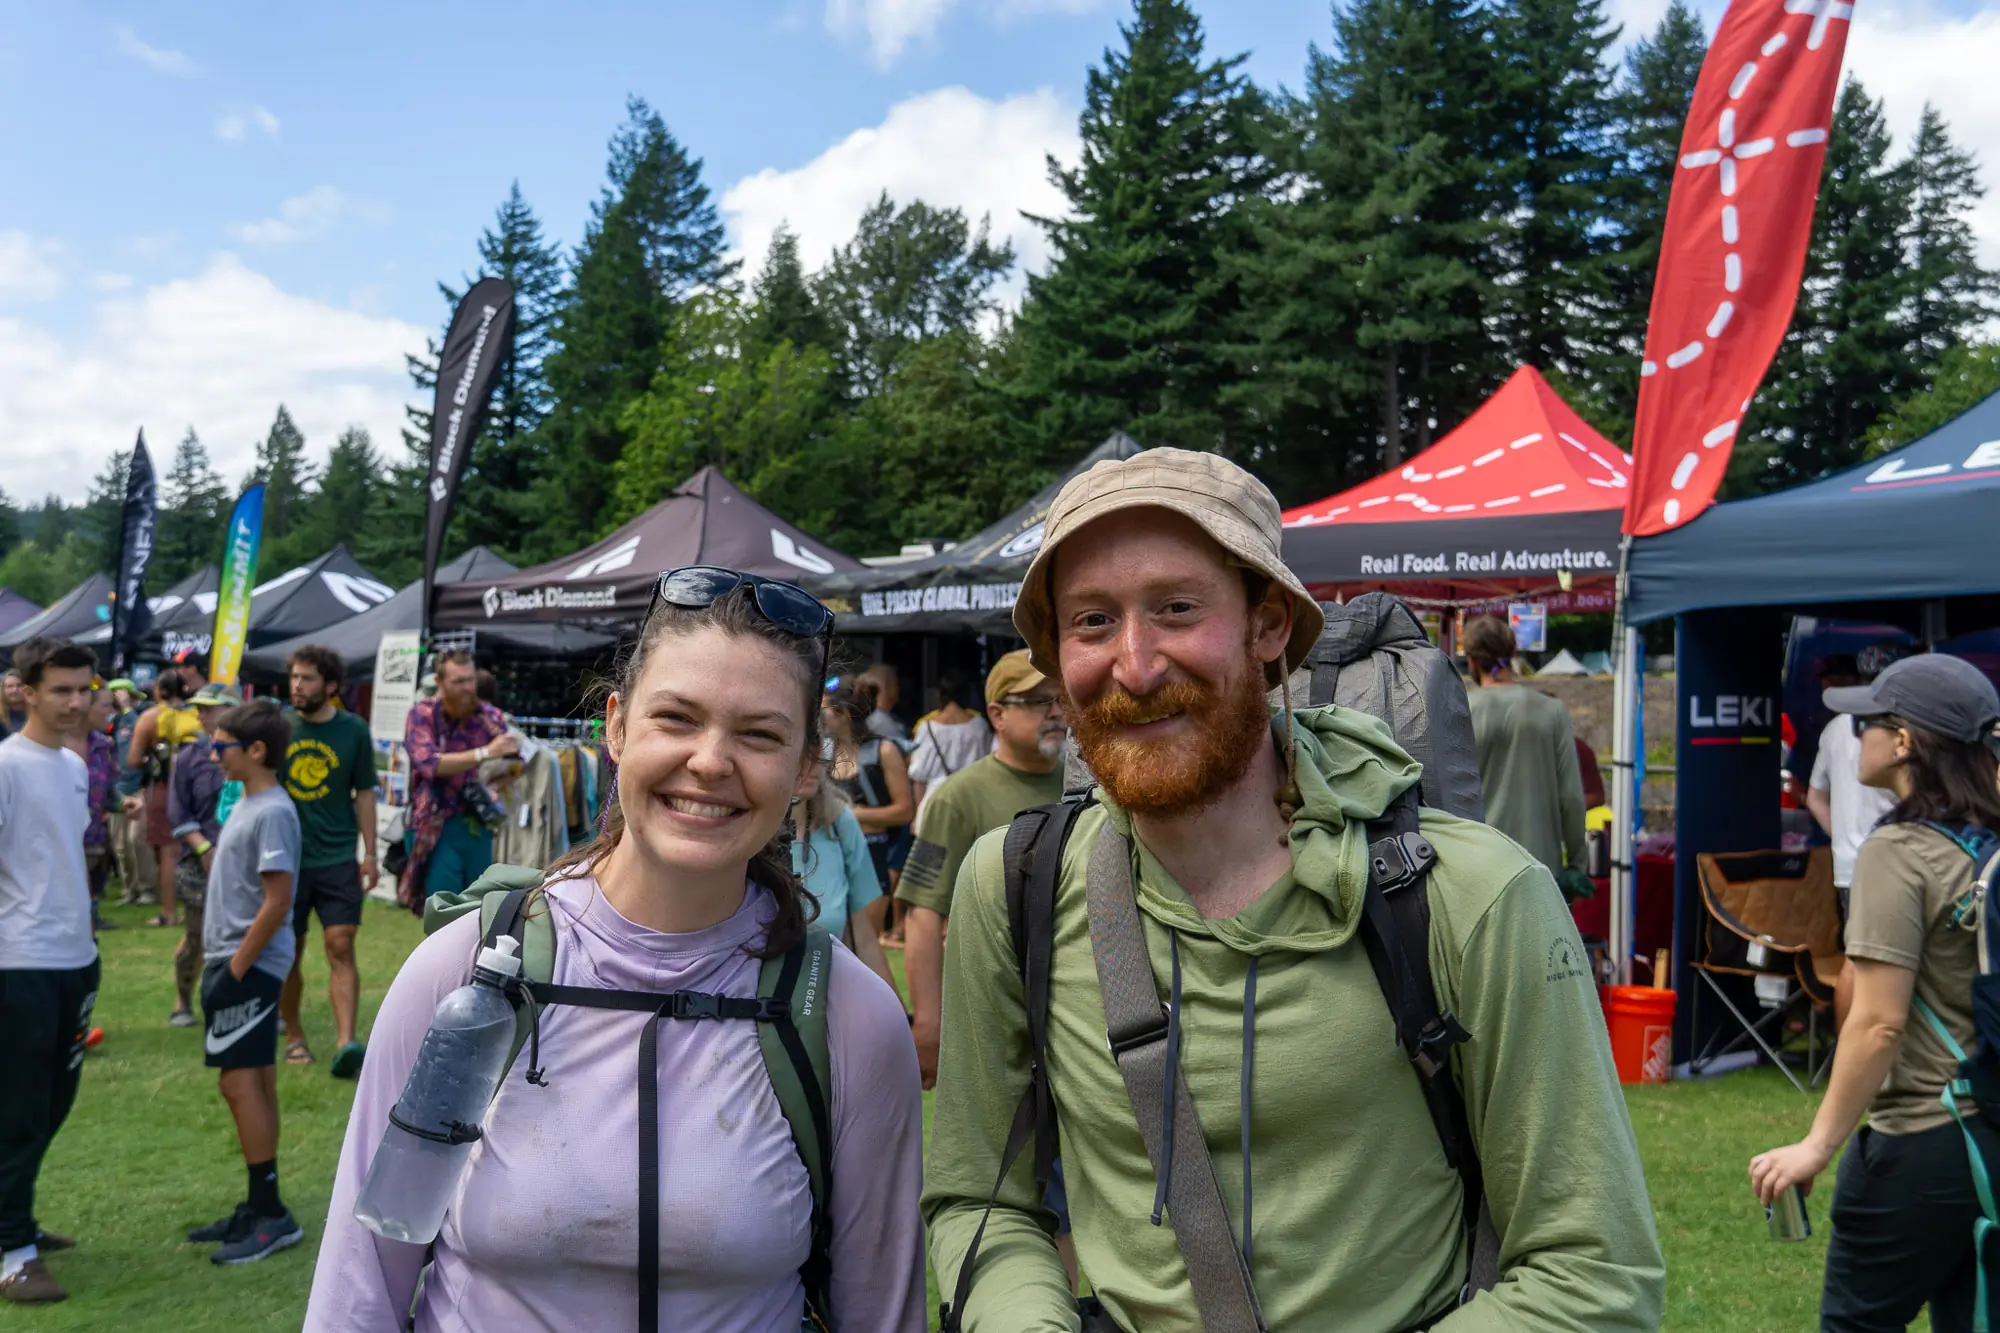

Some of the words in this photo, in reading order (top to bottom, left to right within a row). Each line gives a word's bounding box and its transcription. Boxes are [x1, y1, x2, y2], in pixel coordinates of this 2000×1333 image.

[437, 409, 463, 474] Black
[454, 305, 497, 405] Diamond
[1360, 555, 1399, 575] Real
[1402, 553, 1450, 574] Food.
[1455, 551, 1497, 572] Real
[1501, 548, 1613, 572] Adventure.
[223, 517, 251, 645] SUMMIT
[501, 588, 543, 611] Black
[545, 585, 617, 608] Diamond
[1690, 694, 1772, 728] LEKI
[808, 950, 821, 988] GRANITE
[213, 997, 261, 1034] NIKE
[802, 989, 815, 1015] GEAR
